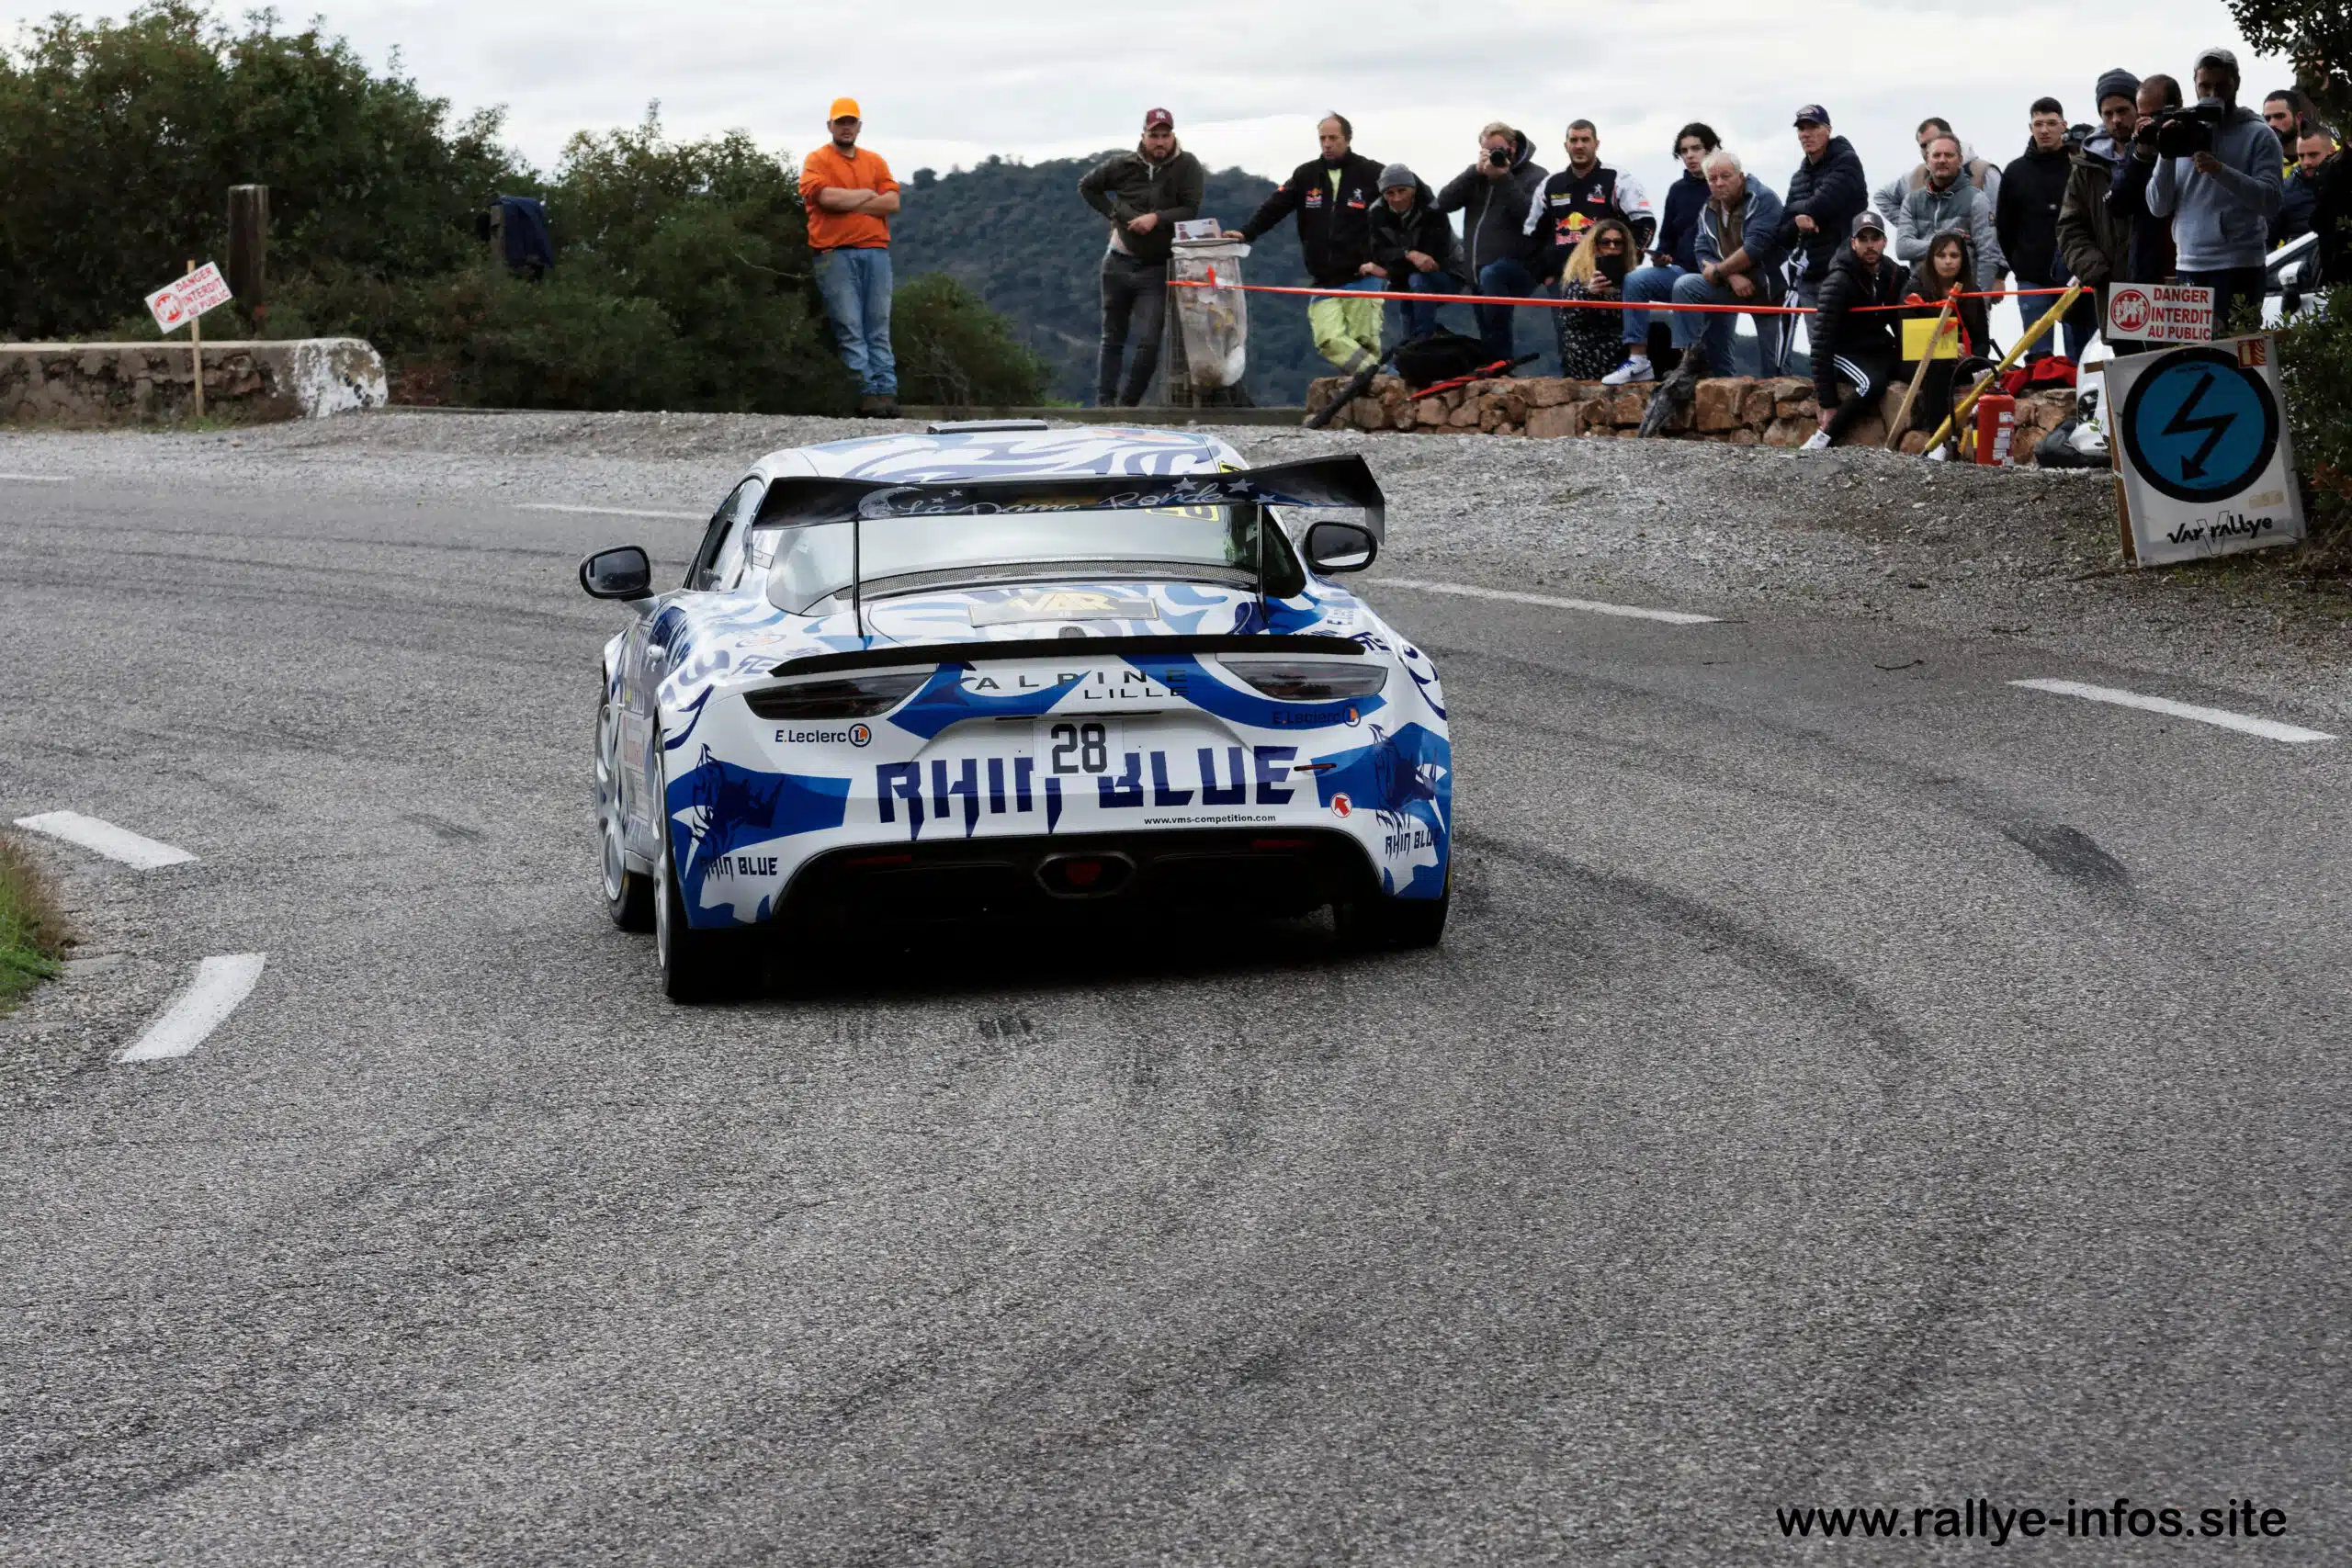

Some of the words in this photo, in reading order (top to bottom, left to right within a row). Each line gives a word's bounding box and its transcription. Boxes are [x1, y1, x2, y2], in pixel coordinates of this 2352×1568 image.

[175, 266, 213, 292] DANGER
[183, 277, 221, 305] INTERDIT
[2154, 288, 2209, 303] DANGER
[2151, 307, 2212, 324] INTERDIT
[2147, 325, 2164, 338] AU
[2168, 326, 2211, 340] PUBLIC
[1098, 482, 1223, 509] Ronde
[975, 669, 1188, 690] ALPINE
[1084, 687, 1189, 700] LILLE
[775, 729, 847, 743] E.Leclerc
[1050, 722, 1108, 774] 28
[876, 756, 1063, 841] RHIN
[1098, 746, 1299, 808] BLUE
[1144, 813, 1276, 825] www.vms-competition.com
[738, 856, 778, 875] BLUE
